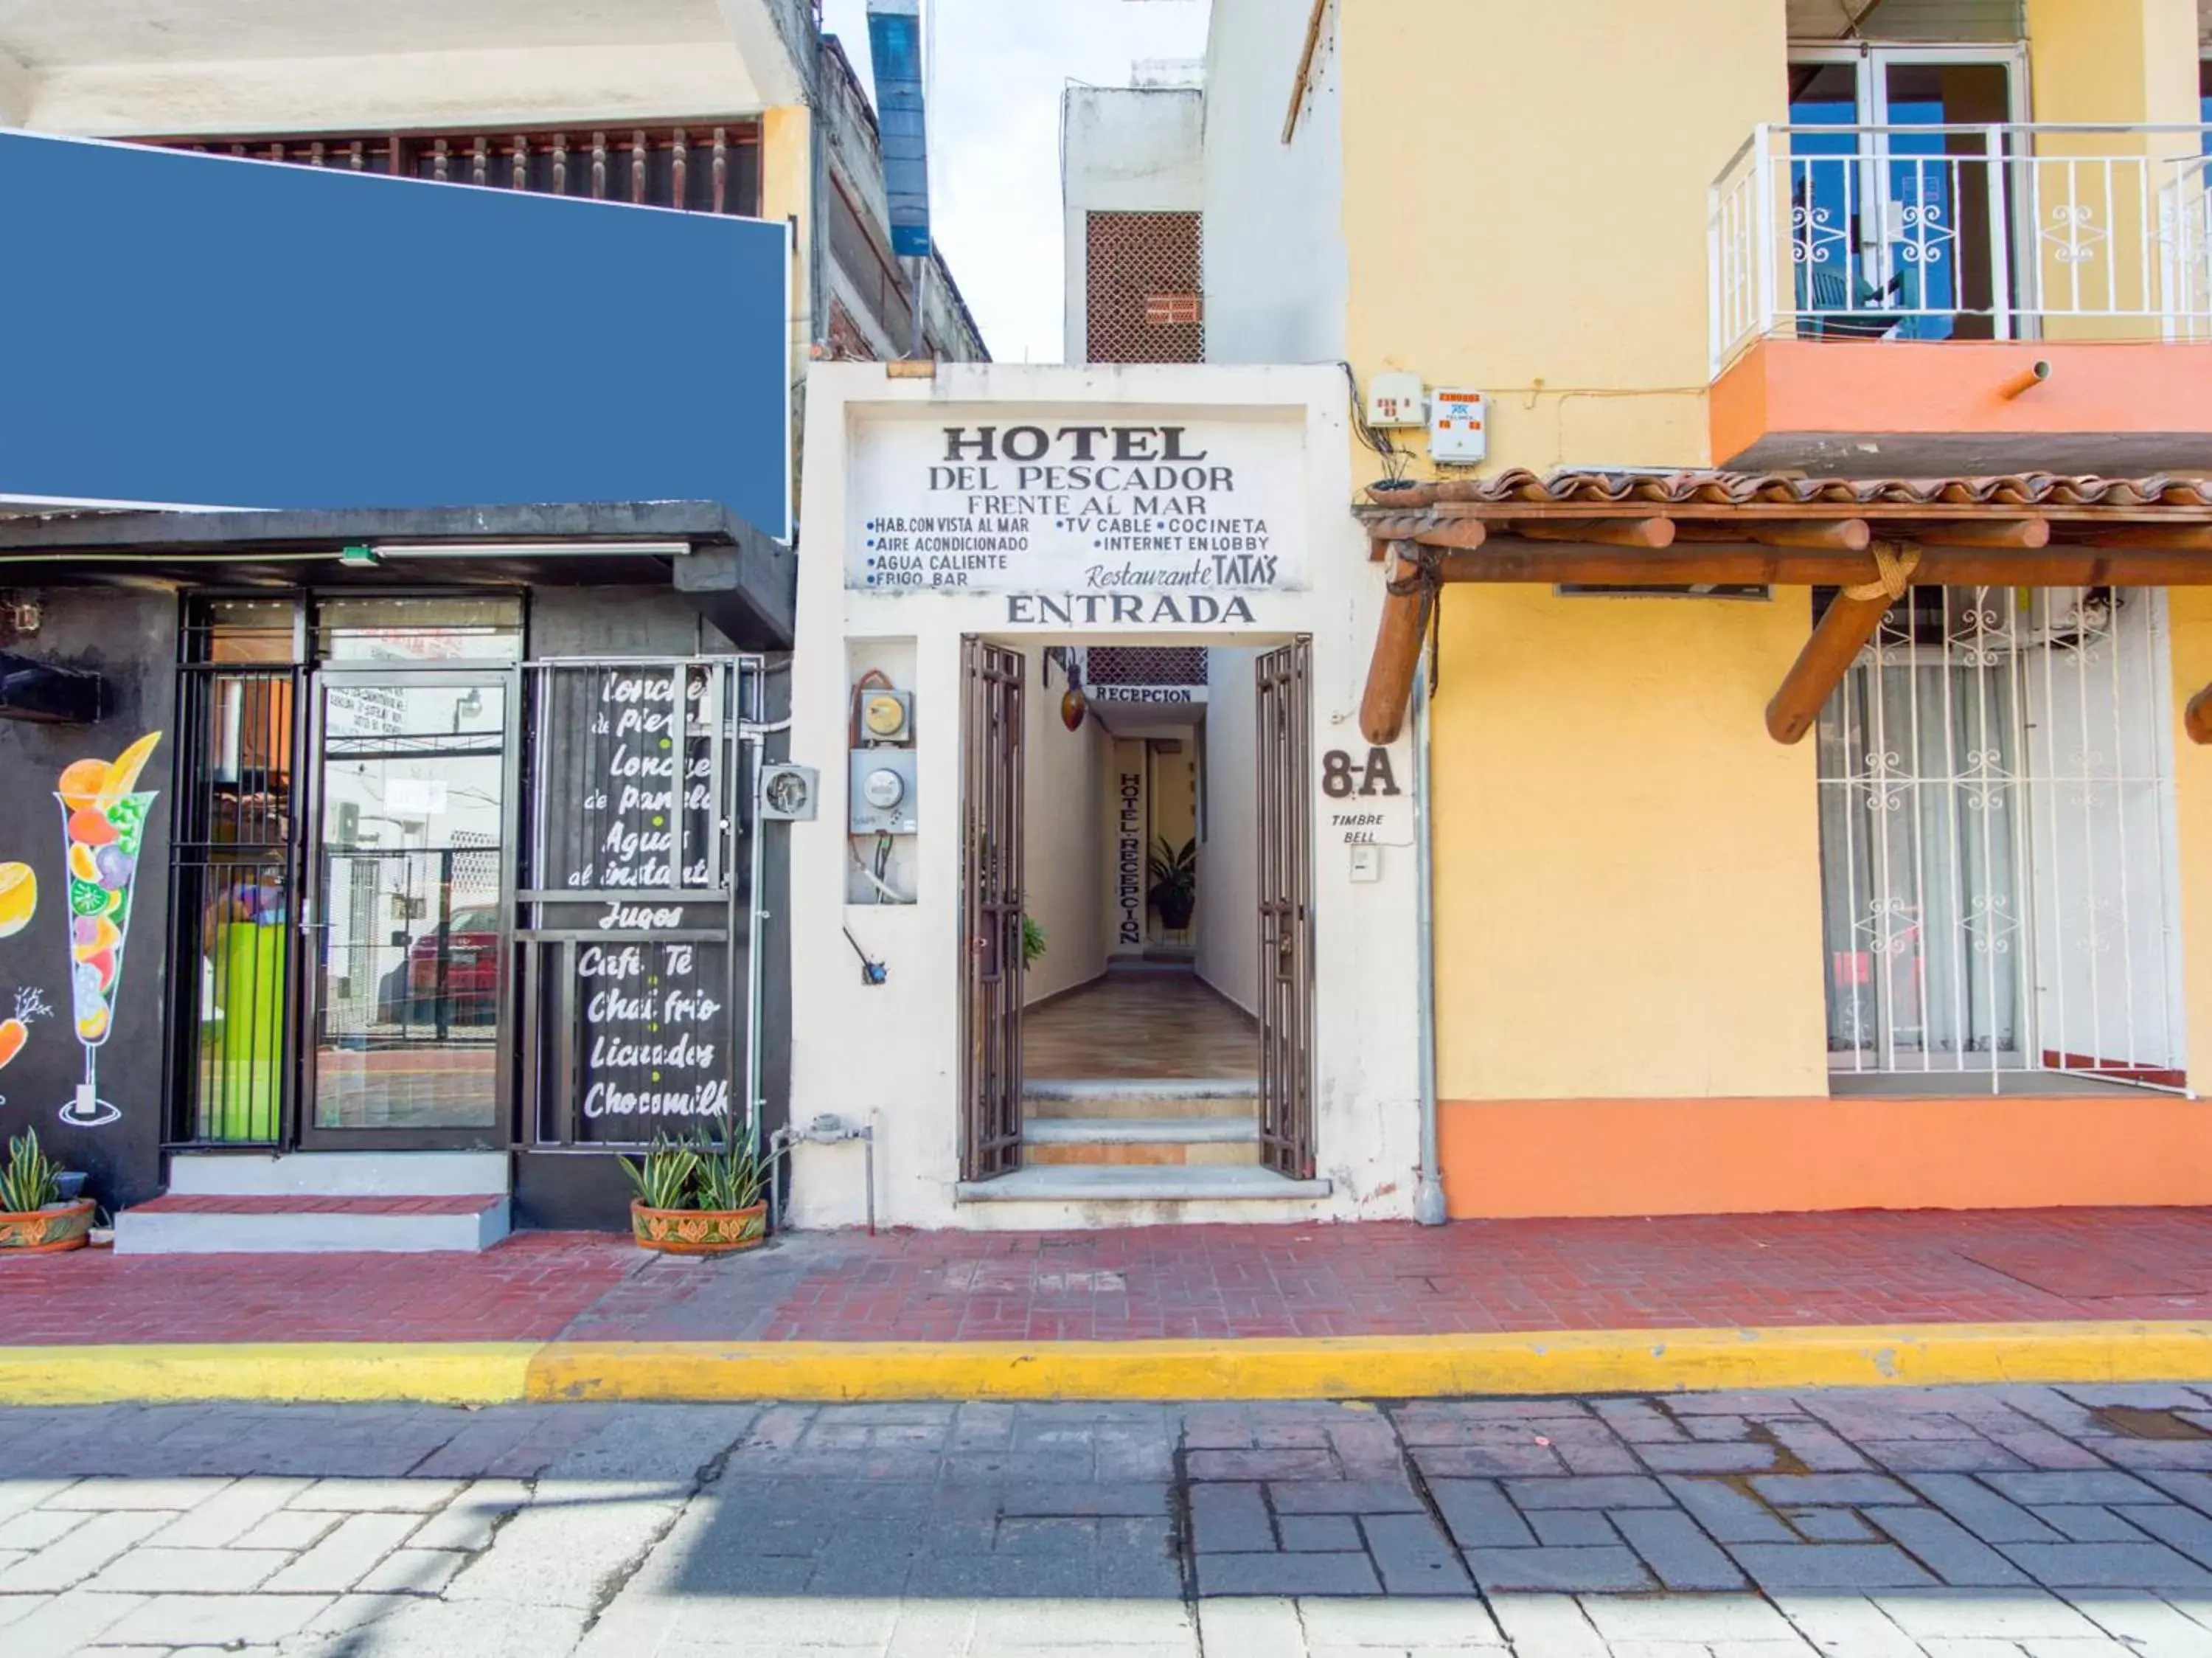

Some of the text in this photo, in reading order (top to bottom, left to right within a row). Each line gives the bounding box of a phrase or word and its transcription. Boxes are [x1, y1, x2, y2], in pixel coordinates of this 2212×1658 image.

[943, 426, 1207, 461] HOTEL
[928, 465, 1234, 491] DEL PESCADOR
[968, 495, 1206, 517] FRENTE AL MAR
[937, 518, 971, 532] VISTA
[978, 518, 993, 533] AL
[998, 518, 1029, 533] MAR
[1067, 518, 1267, 533] TV CABLE COCINETA
[876, 538, 1029, 551] AIRE ACONDICIONADO
[1104, 536, 1269, 551] INTERNET EN LOBBY
[876, 555, 1008, 570] AGUA CALIENTE
[1085, 558, 1211, 589] Restaurante
[877, 572, 968, 586] FRIGO BAR
[1006, 594, 1256, 623] ENTRADA
[1096, 687, 1192, 702] RECEPCION
[1322, 747, 1401, 798] 8-A
[1332, 815, 1385, 826] TIMBRE
[1344, 831, 1375, 844] BELL
[1120, 774, 1140, 945] HOTEL RECEPCION
[568, 863, 593, 886] al
[599, 901, 684, 930] Jugos
[585, 1079, 728, 1119] Chocomilk
